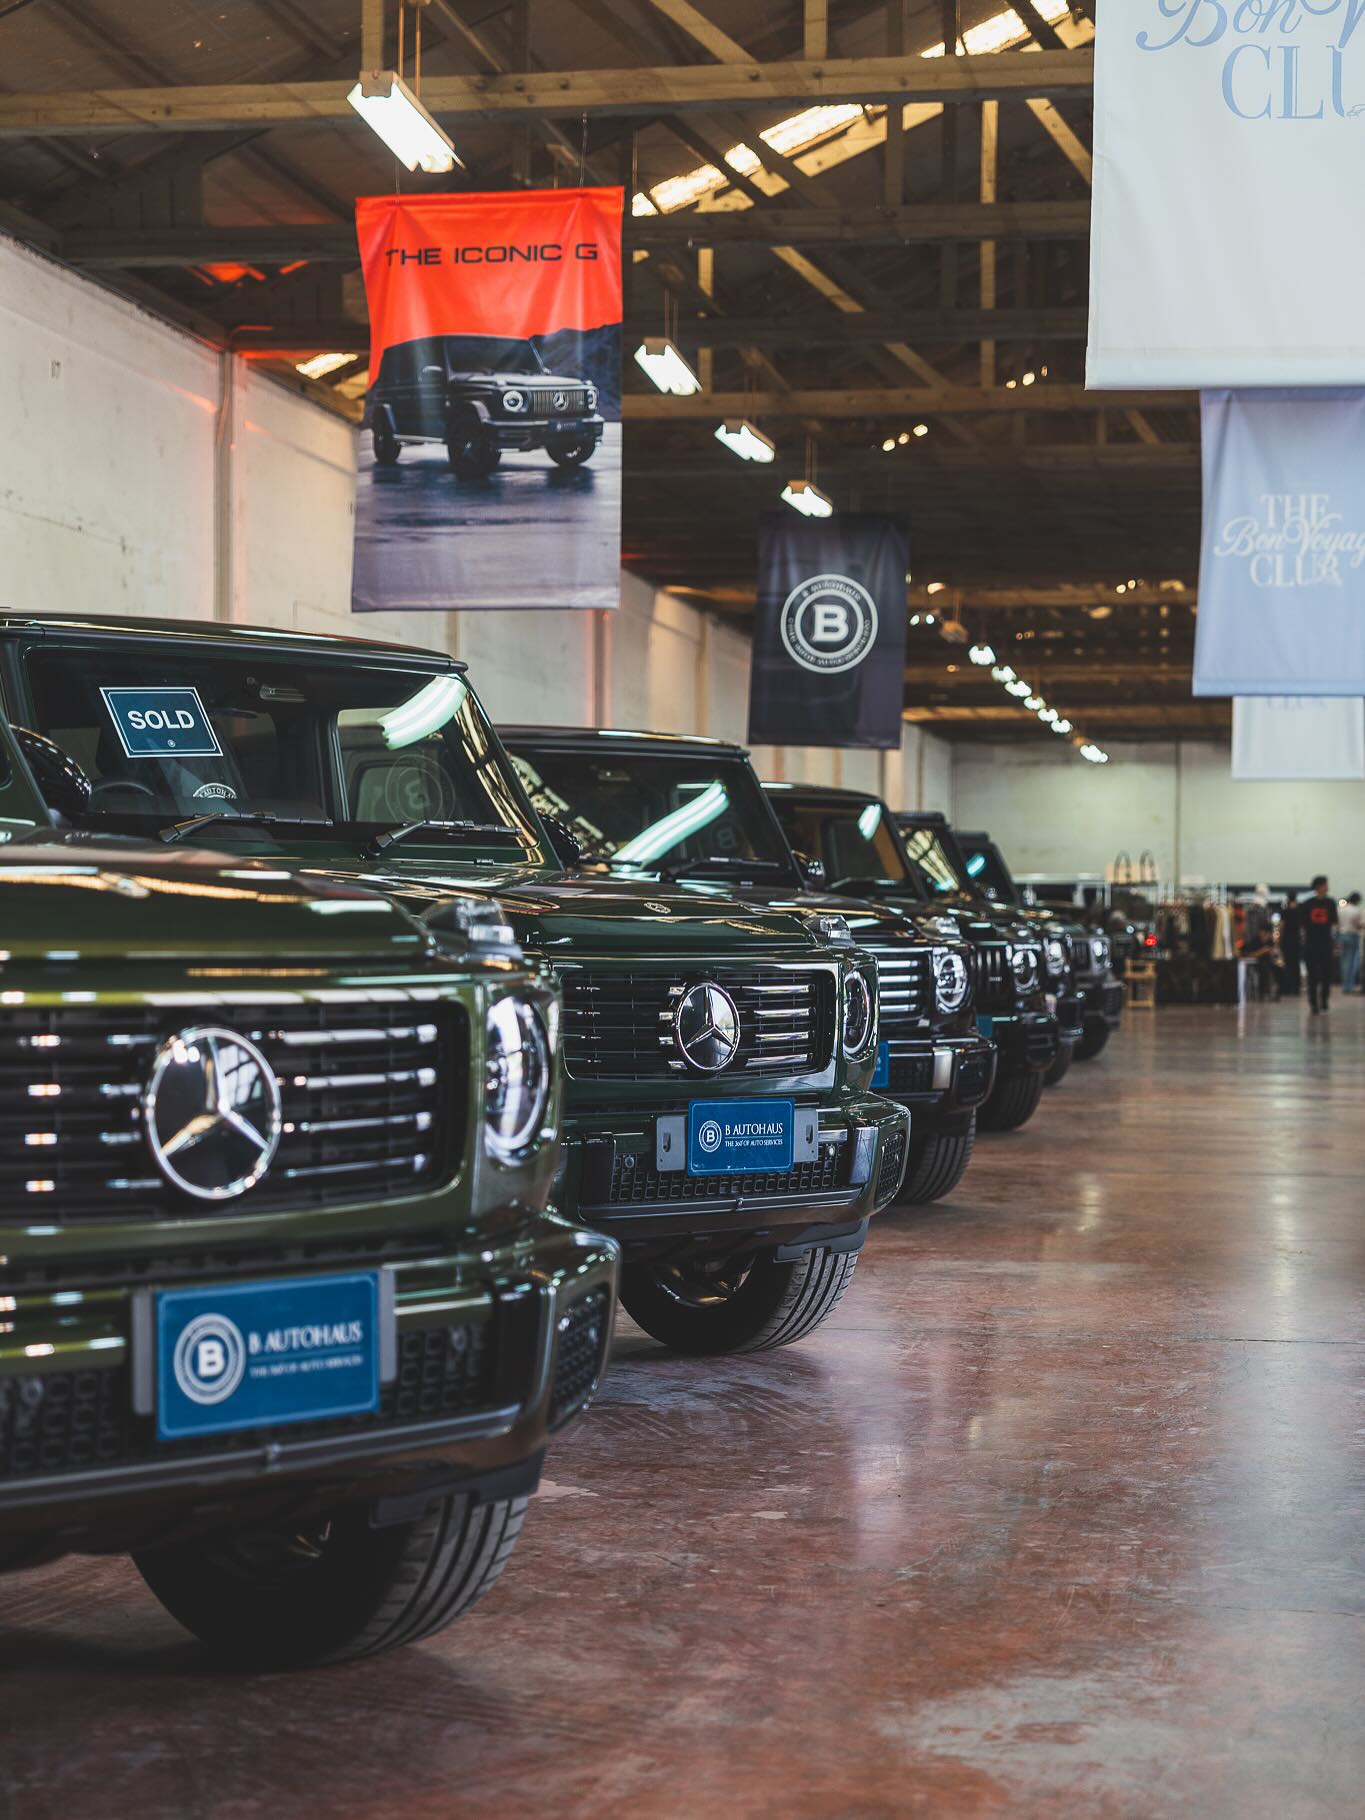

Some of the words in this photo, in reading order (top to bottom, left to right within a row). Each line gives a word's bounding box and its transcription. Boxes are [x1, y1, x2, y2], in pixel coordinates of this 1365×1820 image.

[385, 247, 442, 267] THE
[454, 244, 562, 264] ICONIC
[575, 243, 598, 261] G
[1260, 493, 1329, 529] THE
[1213, 515, 1283, 558] Bon
[812, 603, 849, 643] B
[127, 709, 195, 730] SOLD
[706, 1129, 716, 1143] B
[725, 1124, 731, 1136] B
[733, 1122, 783, 1136] AUTOHAUS
[264, 1321, 362, 1352] AUTOHAUS
[197, 1339, 226, 1378] B
